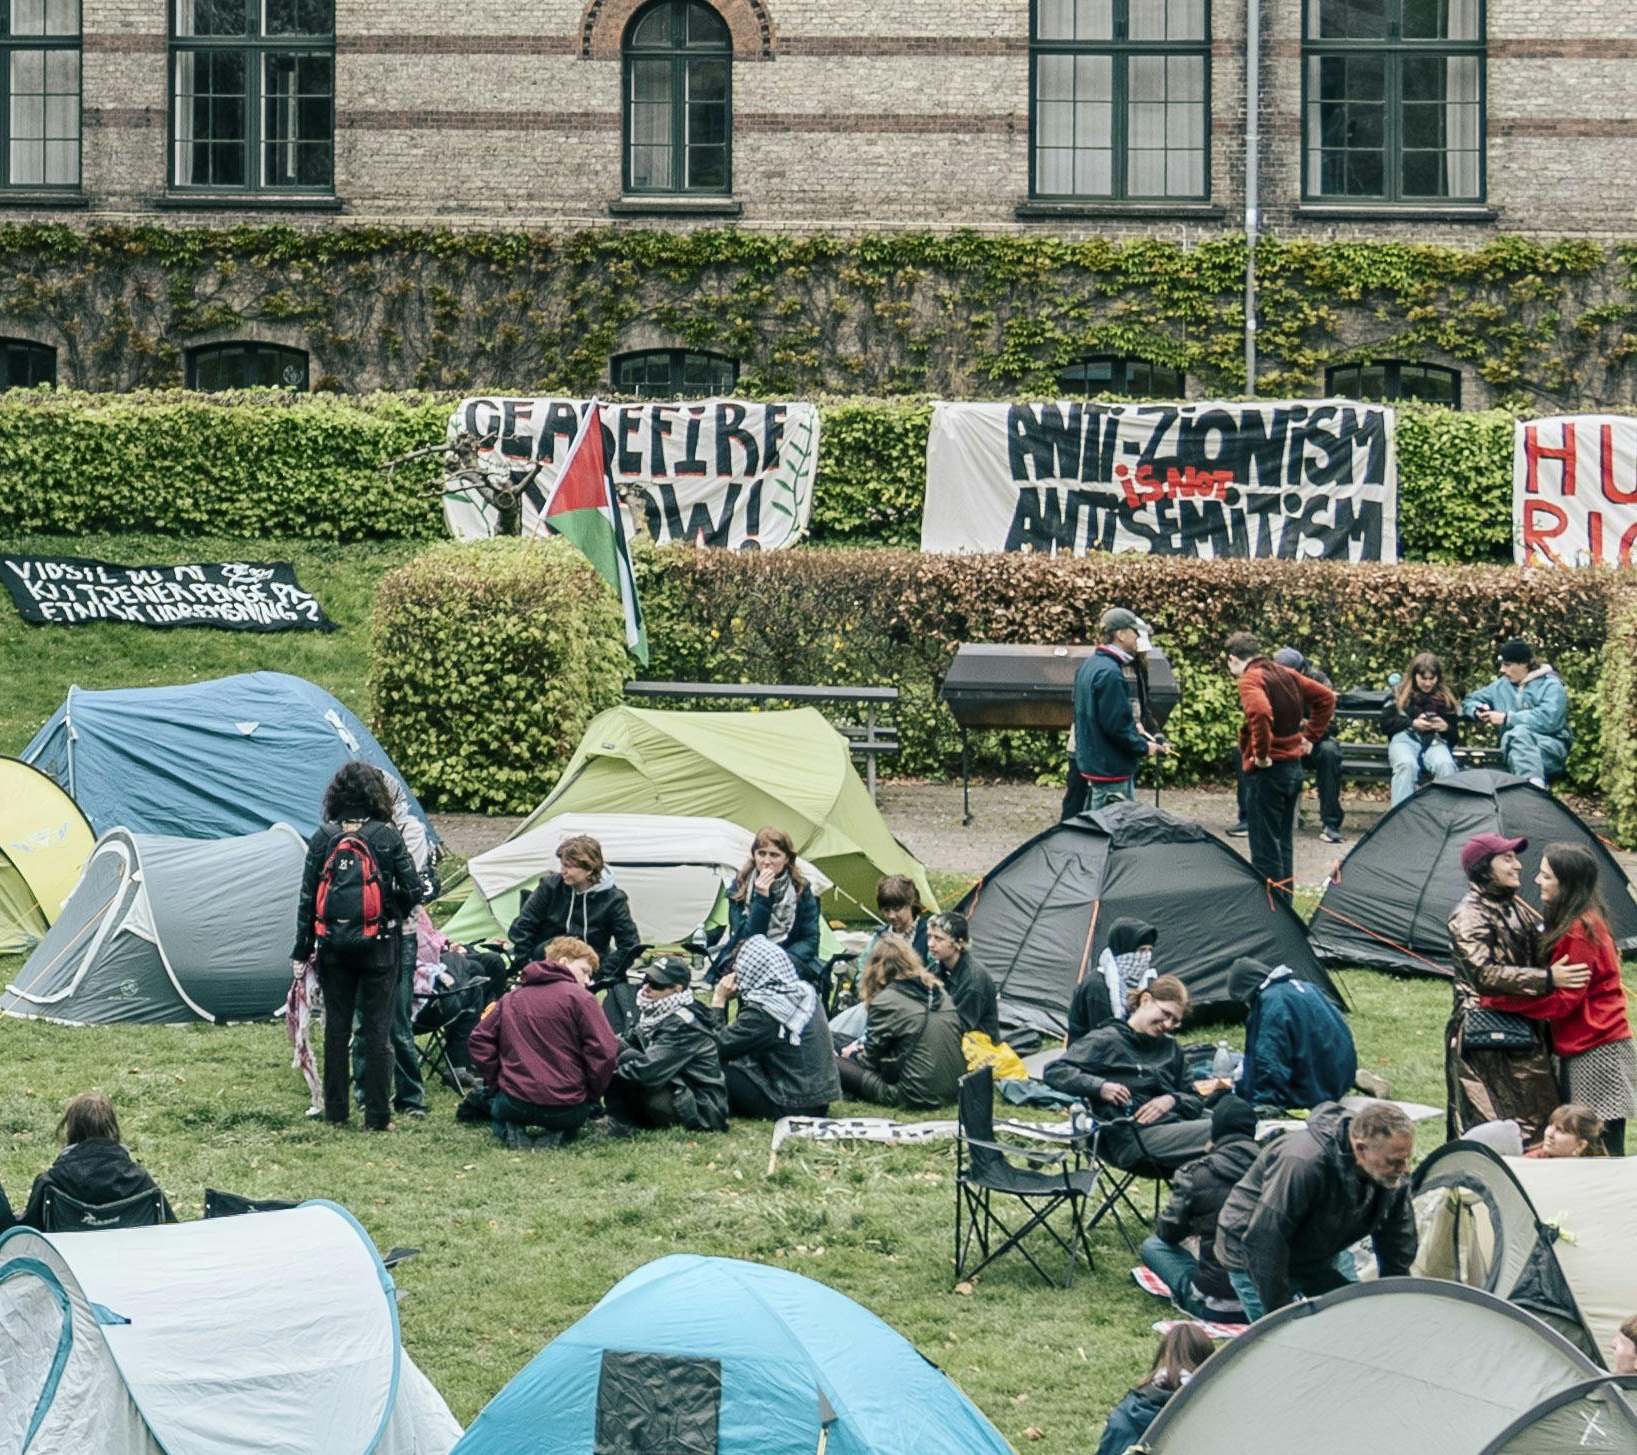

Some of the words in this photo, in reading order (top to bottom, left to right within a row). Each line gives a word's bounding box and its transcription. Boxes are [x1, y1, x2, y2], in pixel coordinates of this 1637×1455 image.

[1166, 465, 1234, 501] NOT
[76, 582, 196, 605] TJENER
[189, 582, 267, 604] PENGE
